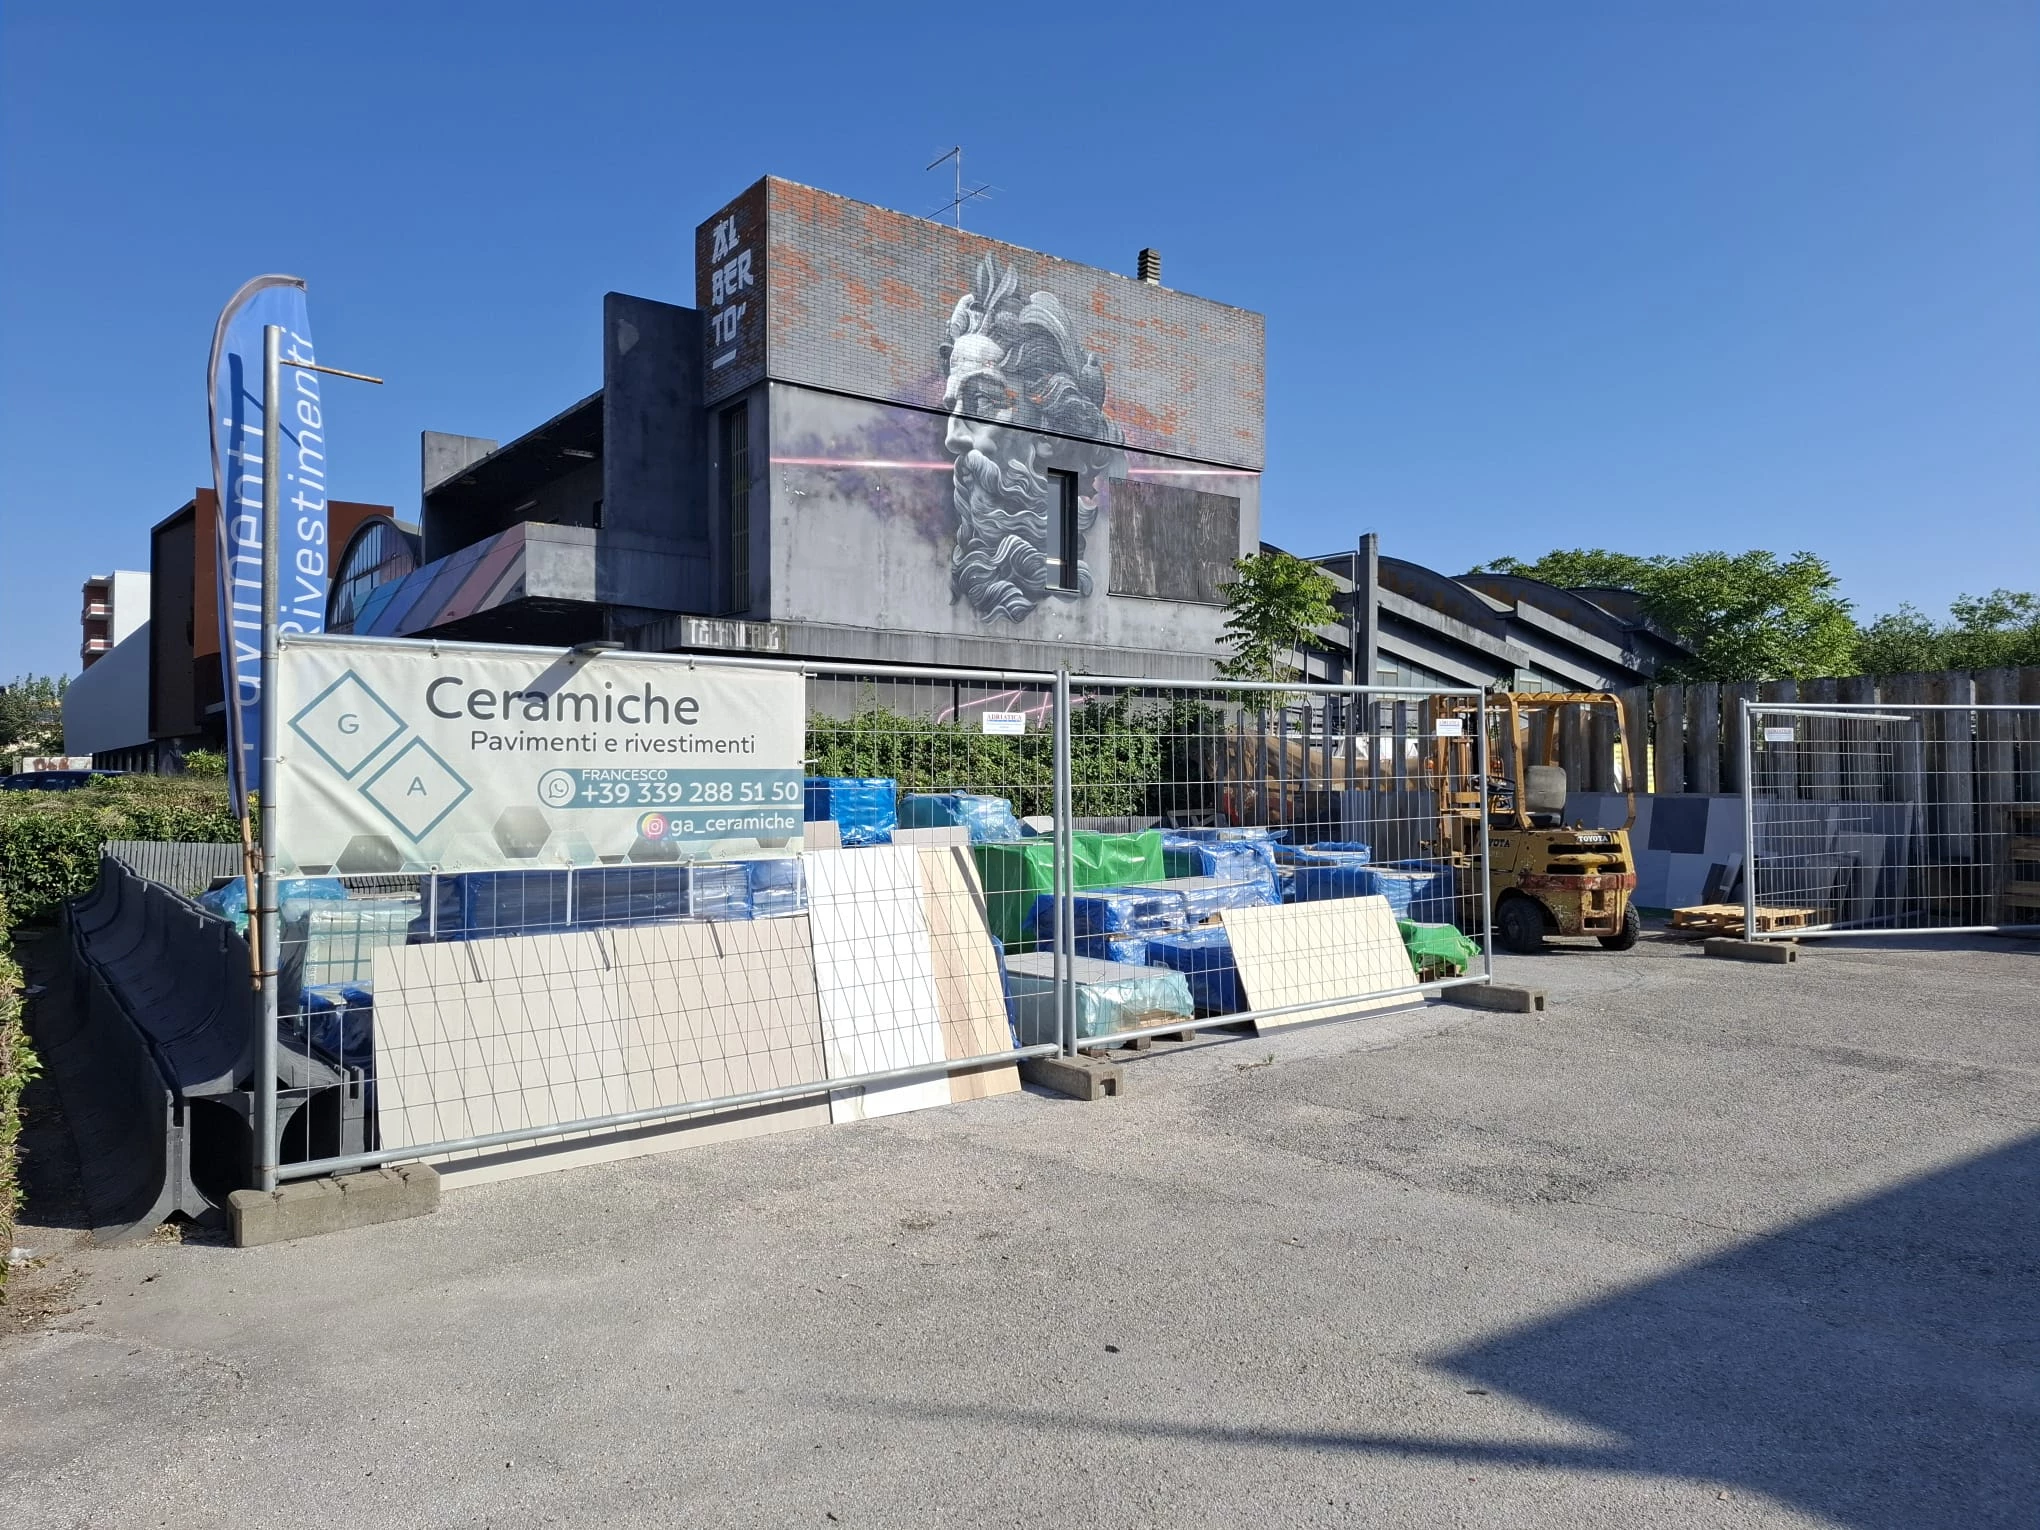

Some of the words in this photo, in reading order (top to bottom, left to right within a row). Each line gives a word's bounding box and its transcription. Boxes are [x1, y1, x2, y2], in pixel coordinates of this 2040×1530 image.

[712, 249, 754, 306] BER
[223, 417, 264, 750] avimenti
[426, 676, 700, 725] Ceramiche
[338, 714, 359, 734] G
[471, 730, 597, 752] Pavimenti
[604, 738, 618, 752] e
[625, 733, 756, 755] rivestimenti
[407, 777, 427, 796] A
[582, 769, 668, 781] FRANCESCO
[581, 783, 630, 804] +39
[637, 783, 682, 803] 339
[689, 782, 733, 802] 288
[739, 782, 765, 801] 51
[771, 781, 799, 801] 50
[671, 812, 796, 837] ga_ceramiche
[1578, 835, 1608, 843] TOYOTA
